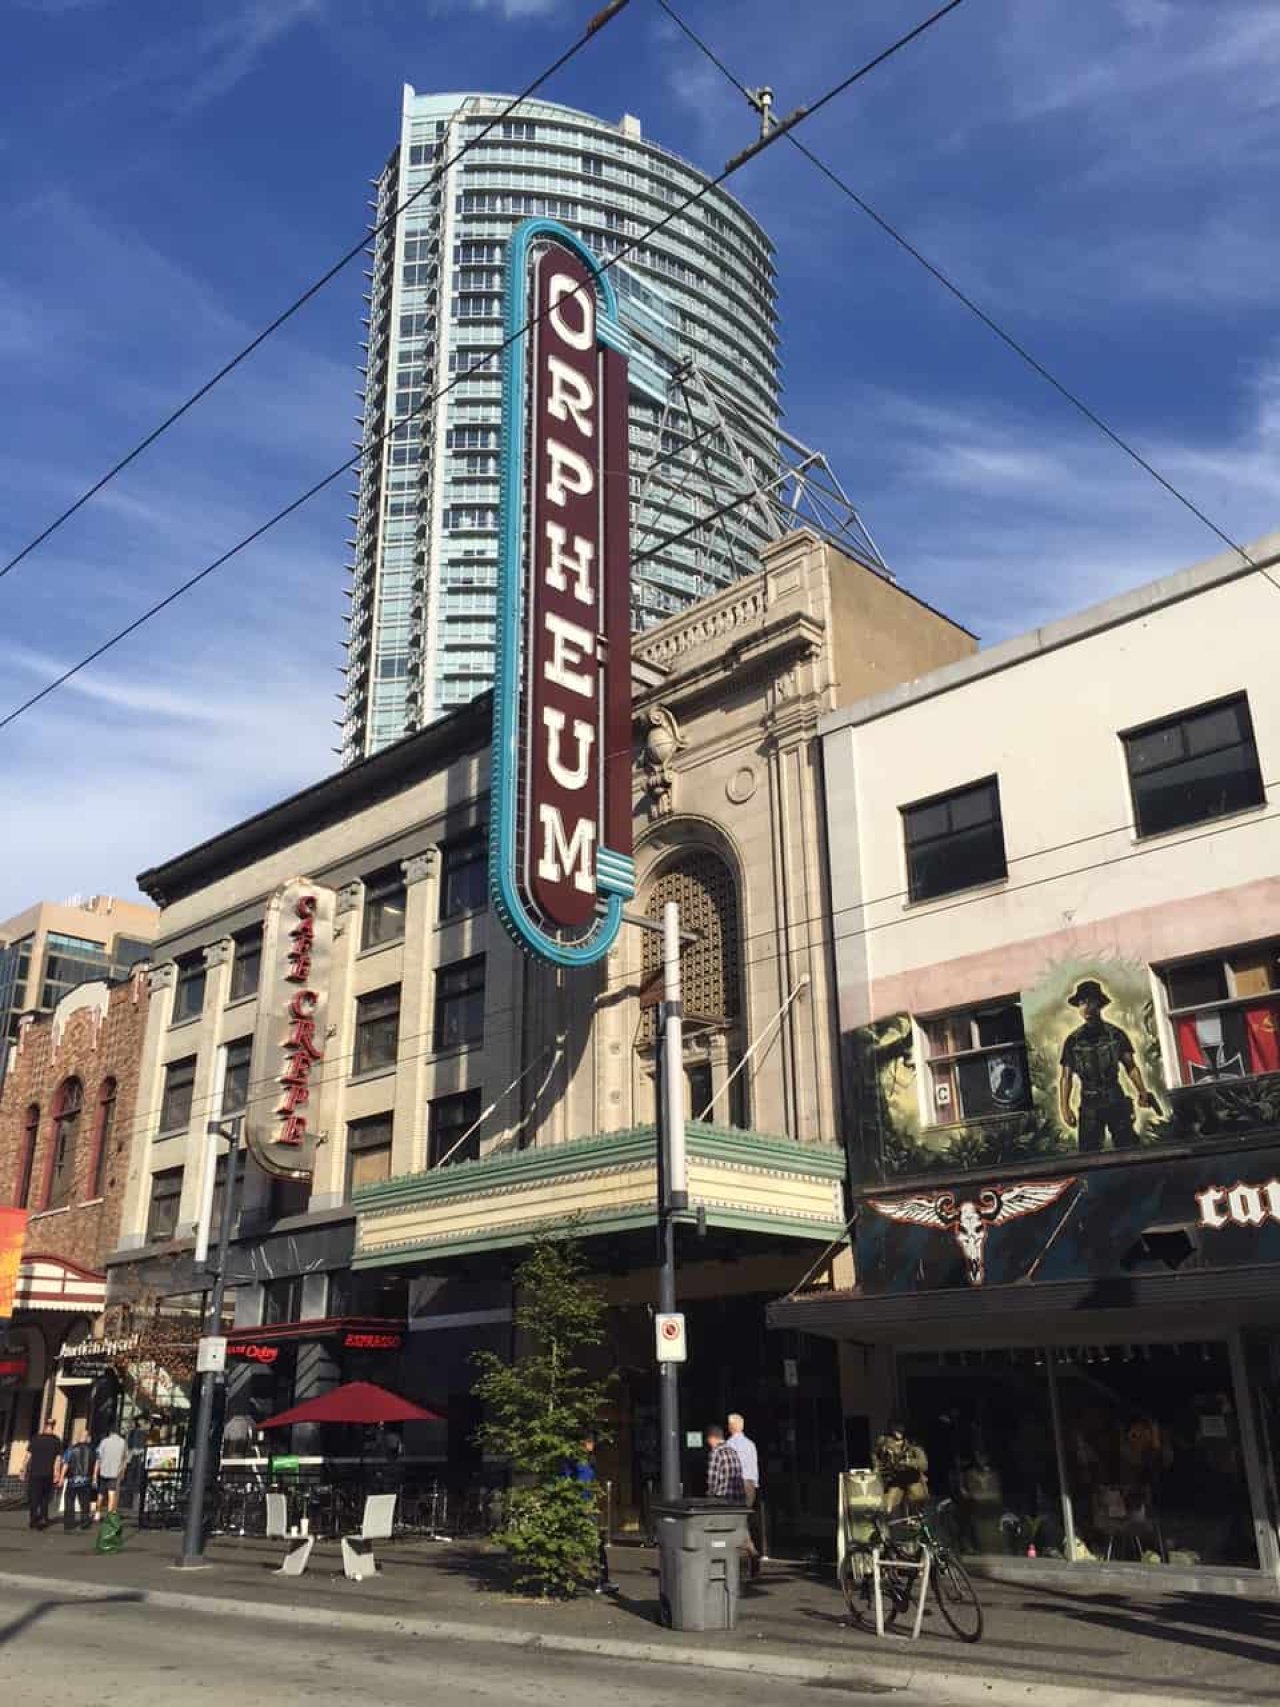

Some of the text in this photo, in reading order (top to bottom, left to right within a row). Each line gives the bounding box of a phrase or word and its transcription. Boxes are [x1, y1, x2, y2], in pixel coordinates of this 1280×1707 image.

[539, 273, 597, 894] ORPHEUM
[277, 896, 322, 1146] CAFE CREPE
